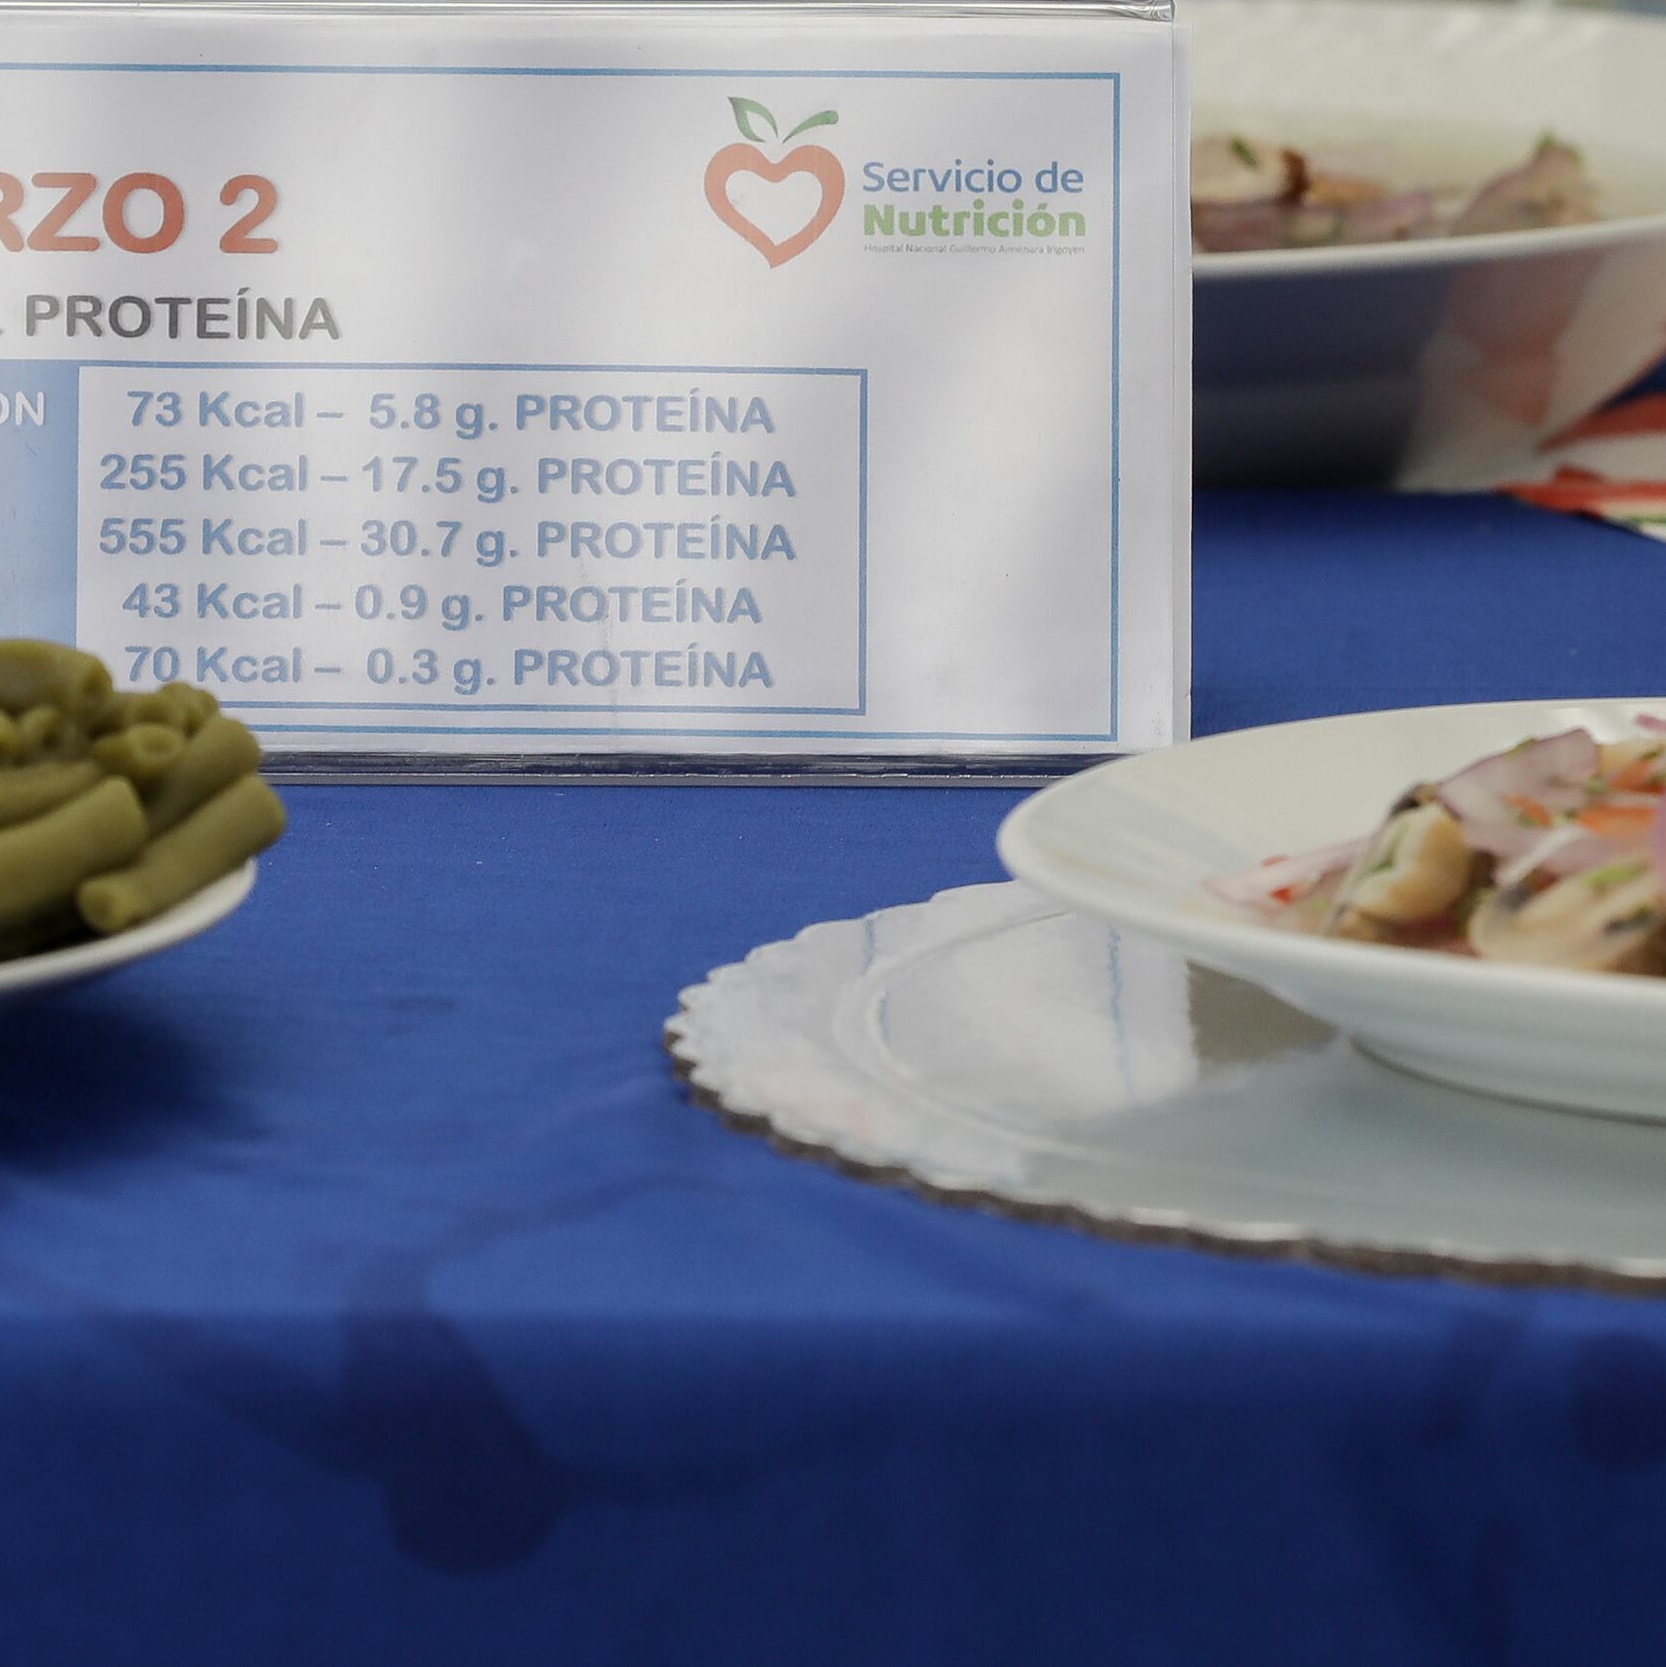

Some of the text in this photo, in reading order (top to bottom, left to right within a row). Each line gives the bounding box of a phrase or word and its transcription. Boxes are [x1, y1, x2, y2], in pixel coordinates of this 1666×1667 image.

[862, 158, 1084, 194] Servicio de
[218, 174, 279, 255] 2
[863, 198, 1086, 238] Nutrición
[25, 286, 340, 340] PROTEÍNA
[126, 390, 183, 428] 73
[198, 390, 304, 429] Kcal
[369, 392, 443, 431] 5.8
[455, 402, 499, 441] g.
[515, 387, 777, 435] PROTEÍNA
[99, 453, 188, 491] 255
[202, 453, 308, 492] Kcal
[362, 455, 464, 495] 17.5
[476, 466, 519, 504] g.
[537, 450, 798, 498] PROTEÍNA
[99, 517, 187, 556] 555
[201, 517, 308, 557] Kcal
[360, 519, 464, 558] 30.7
[475, 530, 519, 568] g.
[537, 514, 797, 562] PROTEÍNA
[121, 582, 181, 619] 43
[196, 582, 303, 620] Kcal
[354, 583, 429, 621] 0.9
[441, 594, 484, 632] g.
[502, 578, 763, 625] PROTEÍNA
[123, 643, 182, 686] 70
[196, 645, 306, 688] Kcal
[366, 647, 440, 686] 0.3
[453, 658, 496, 696] g.
[513, 642, 775, 689] PROTEÍNA
